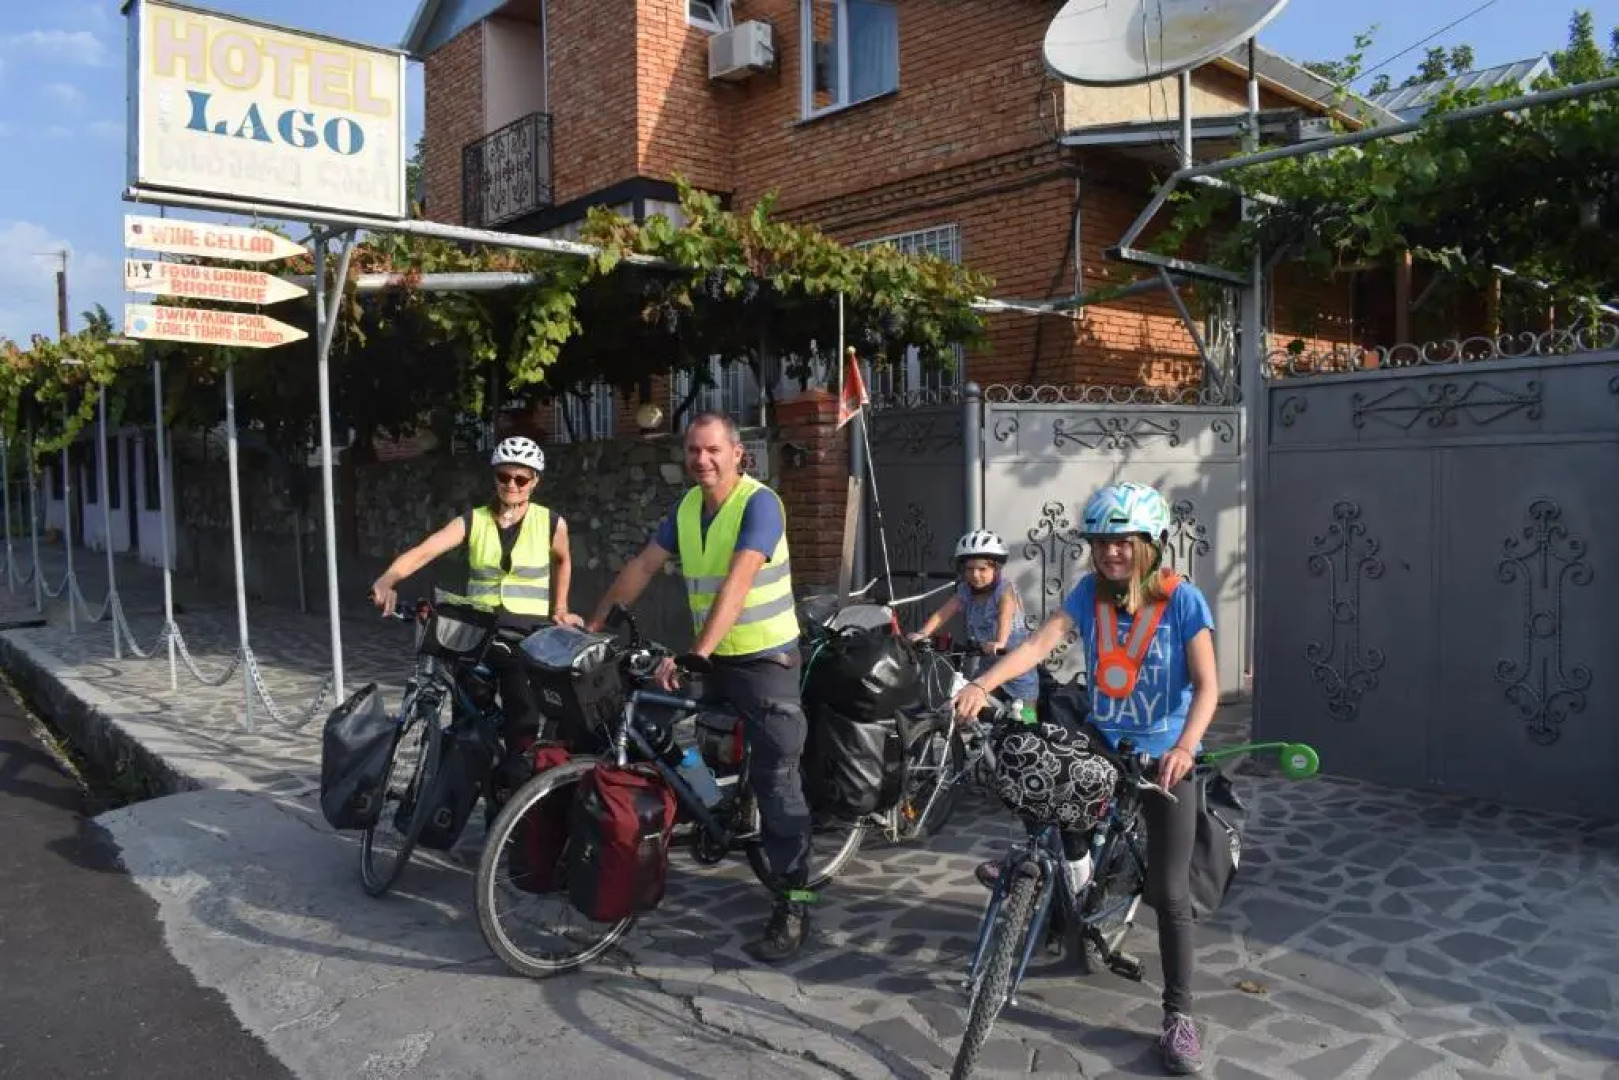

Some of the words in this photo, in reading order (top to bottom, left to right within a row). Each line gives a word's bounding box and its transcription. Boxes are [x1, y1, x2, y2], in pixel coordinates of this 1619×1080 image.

[153, 15, 391, 117] HOTEL
[185, 89, 365, 156] LAGO
[152, 226, 199, 246] WINE
[204, 232, 274, 253] CELLAR
[160, 263, 200, 279] FOOD
[213, 270, 268, 286] DRINKS
[154, 322, 190, 336] TABLE
[194, 325, 232, 340] TENNIS
[237, 315, 267, 329] POOL
